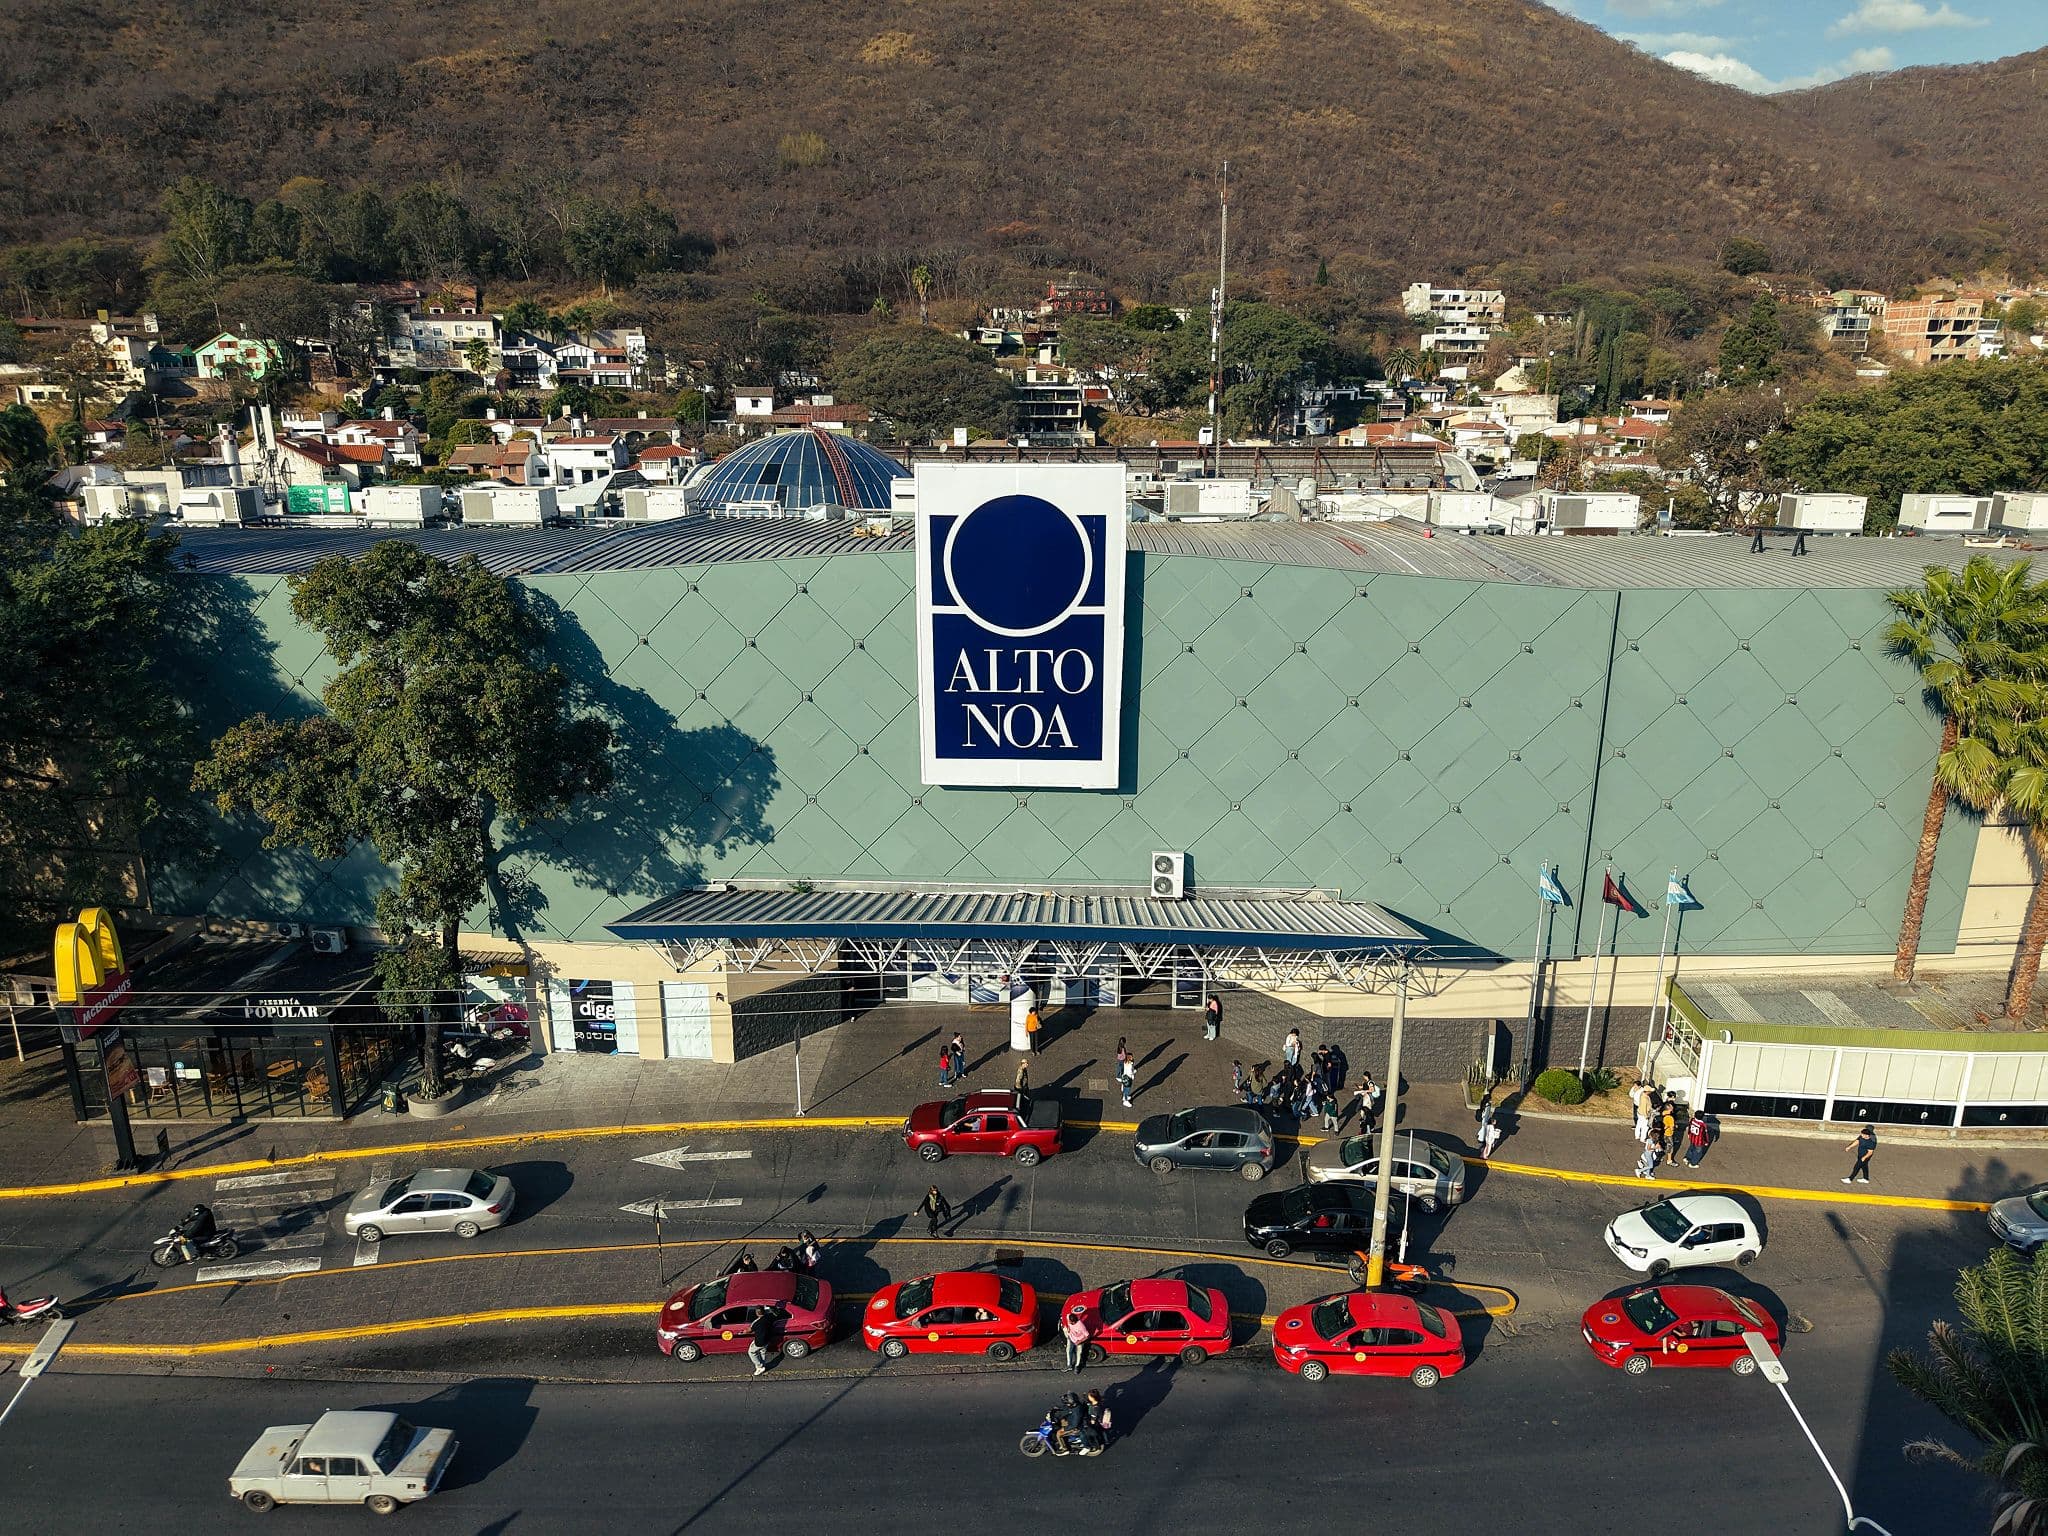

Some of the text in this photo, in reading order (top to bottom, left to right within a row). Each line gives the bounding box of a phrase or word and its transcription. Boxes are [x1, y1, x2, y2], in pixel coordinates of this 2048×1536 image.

[944, 648, 1094, 695] ALTO
[961, 703, 1079, 749] NOA
[82, 978, 132, 1025] McDonald's
[244, 1005, 319, 1019] POPULAR
